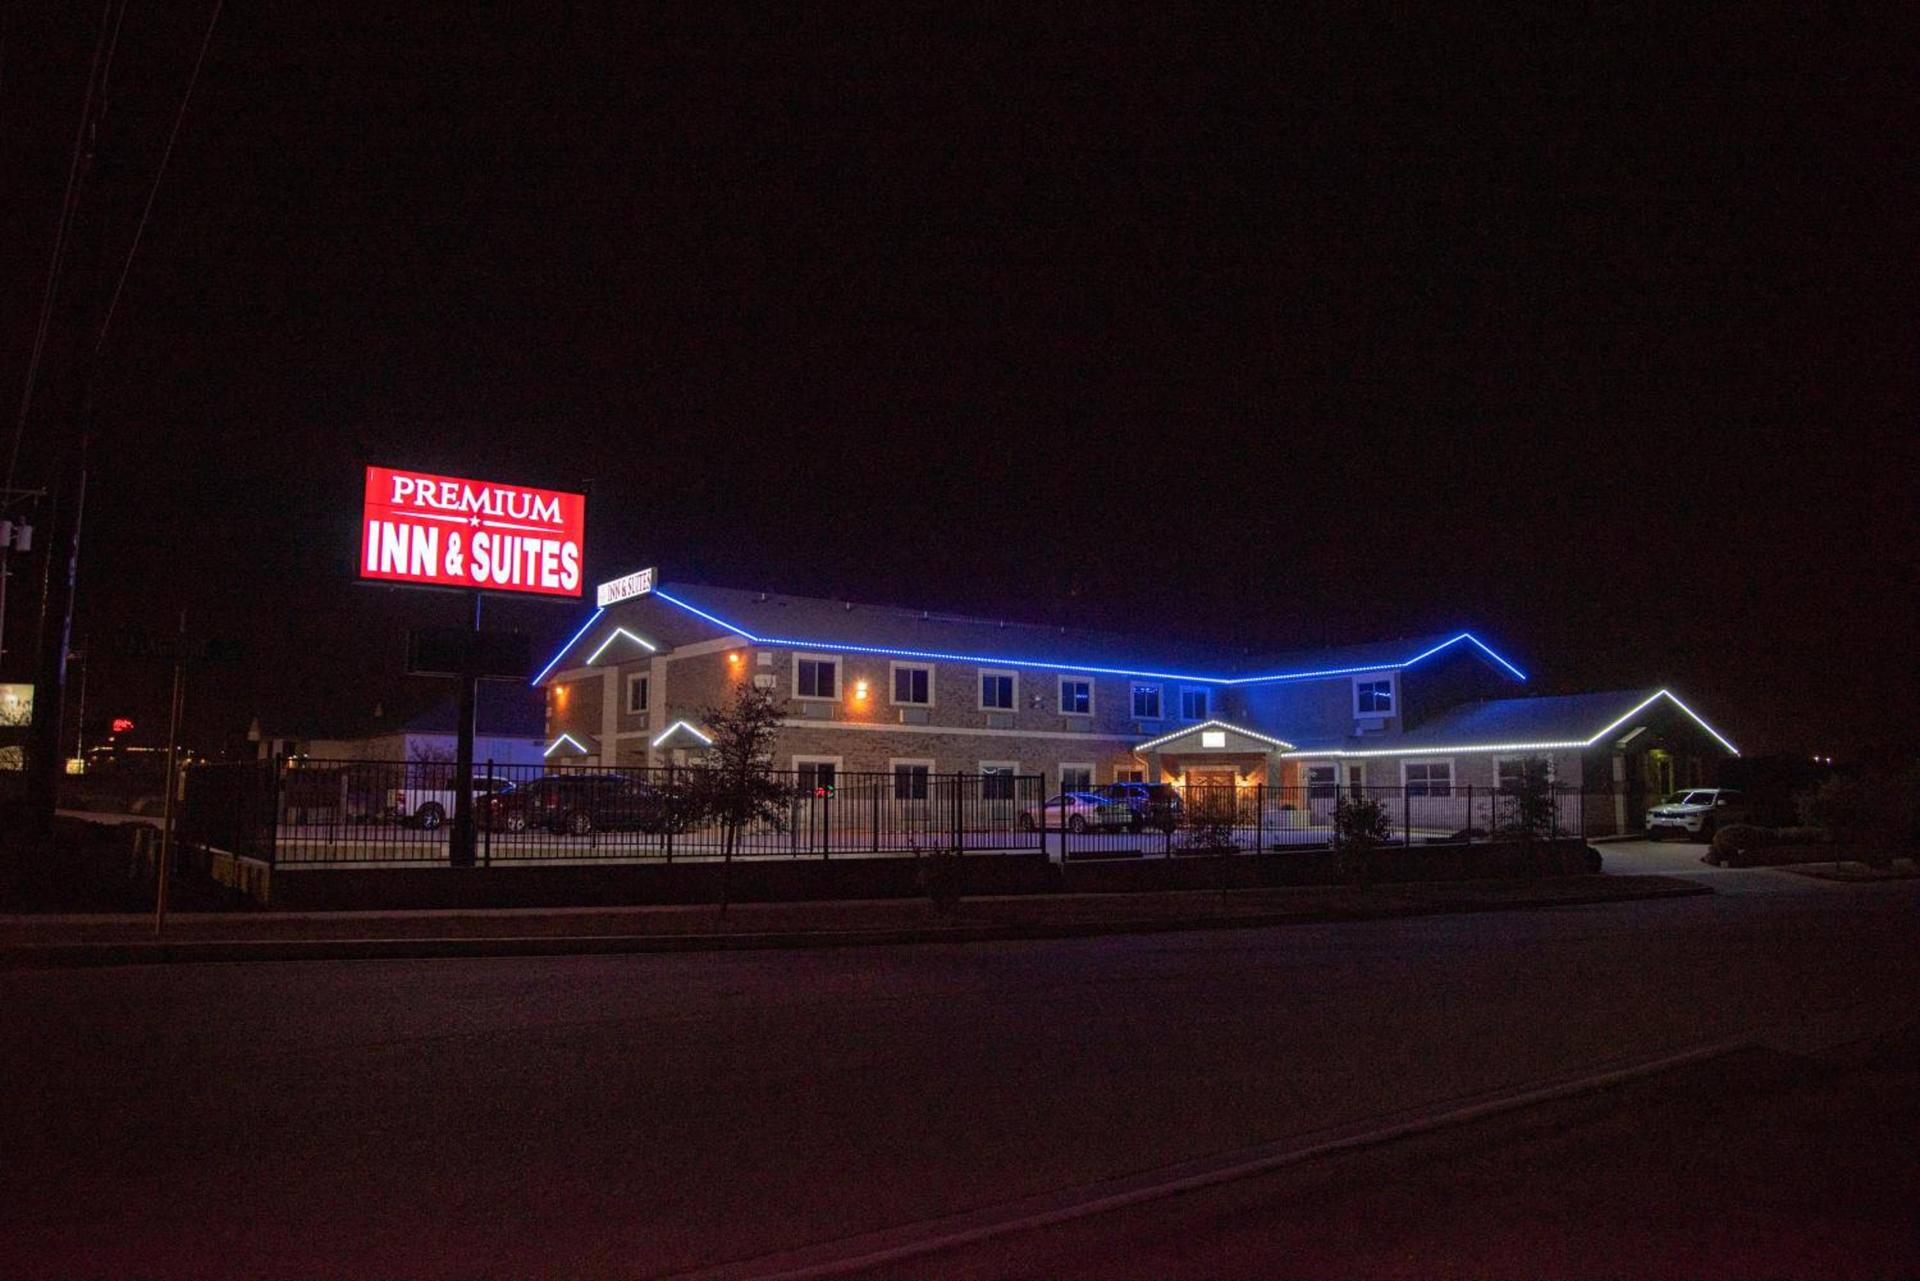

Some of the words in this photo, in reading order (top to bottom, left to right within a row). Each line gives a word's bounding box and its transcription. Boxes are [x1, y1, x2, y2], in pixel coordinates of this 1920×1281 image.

[391, 475, 563, 524] PREMIUM
[367, 520, 439, 577] INN
[445, 531, 465, 576] &
[470, 531, 579, 591] SUITES
